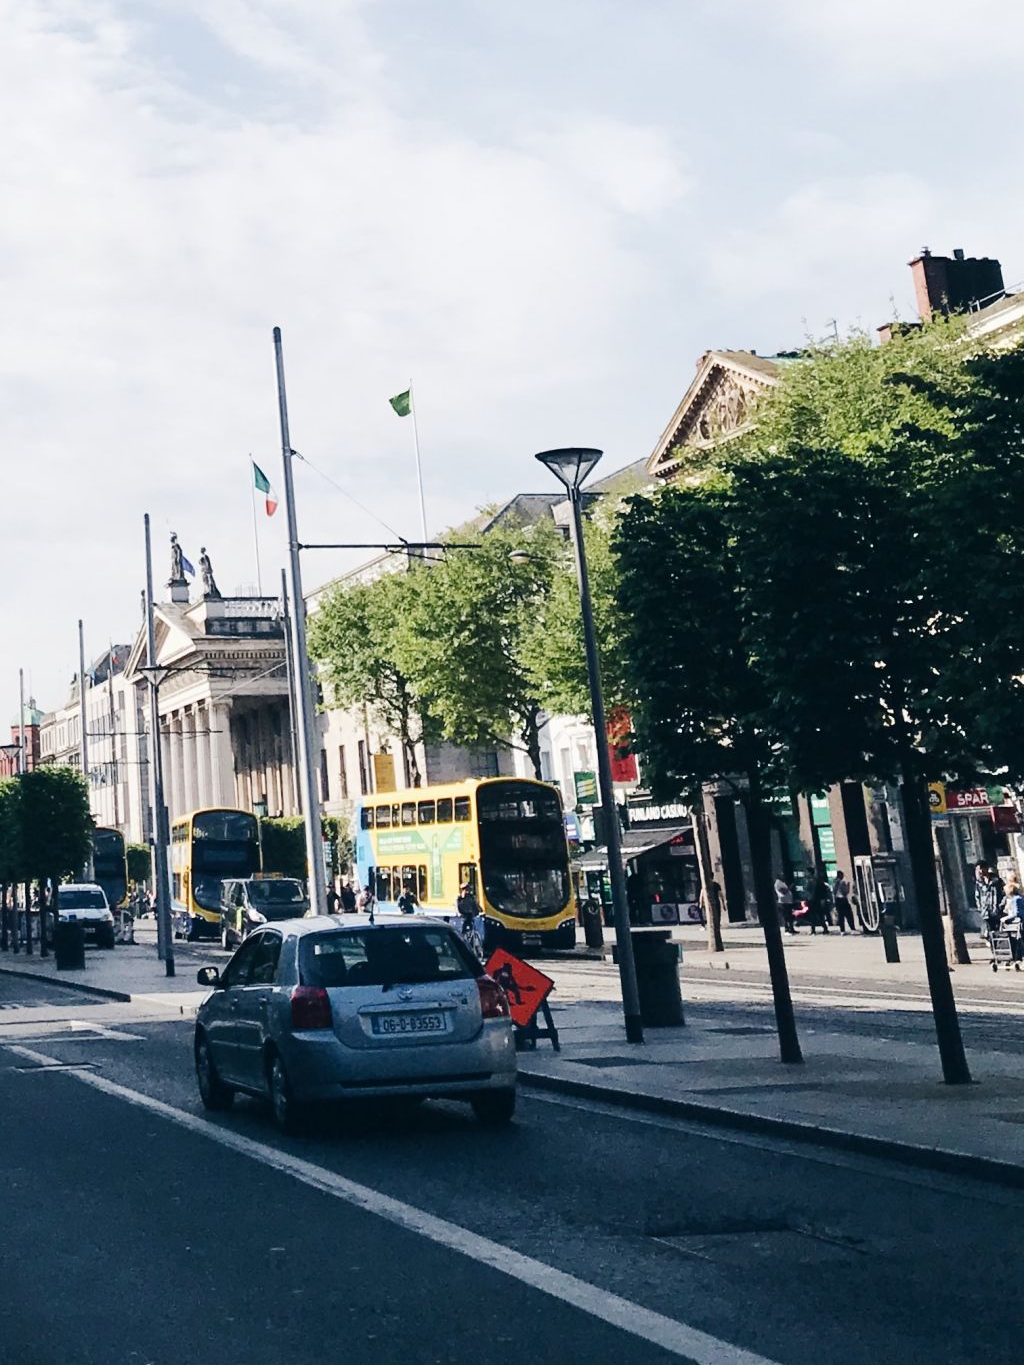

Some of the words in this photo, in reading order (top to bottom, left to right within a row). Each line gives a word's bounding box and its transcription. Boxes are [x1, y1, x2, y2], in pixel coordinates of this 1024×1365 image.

[956, 791, 990, 806] SPAR
[629, 806, 660, 822] FUNLAND
[660, 803, 687, 820] CASINO
